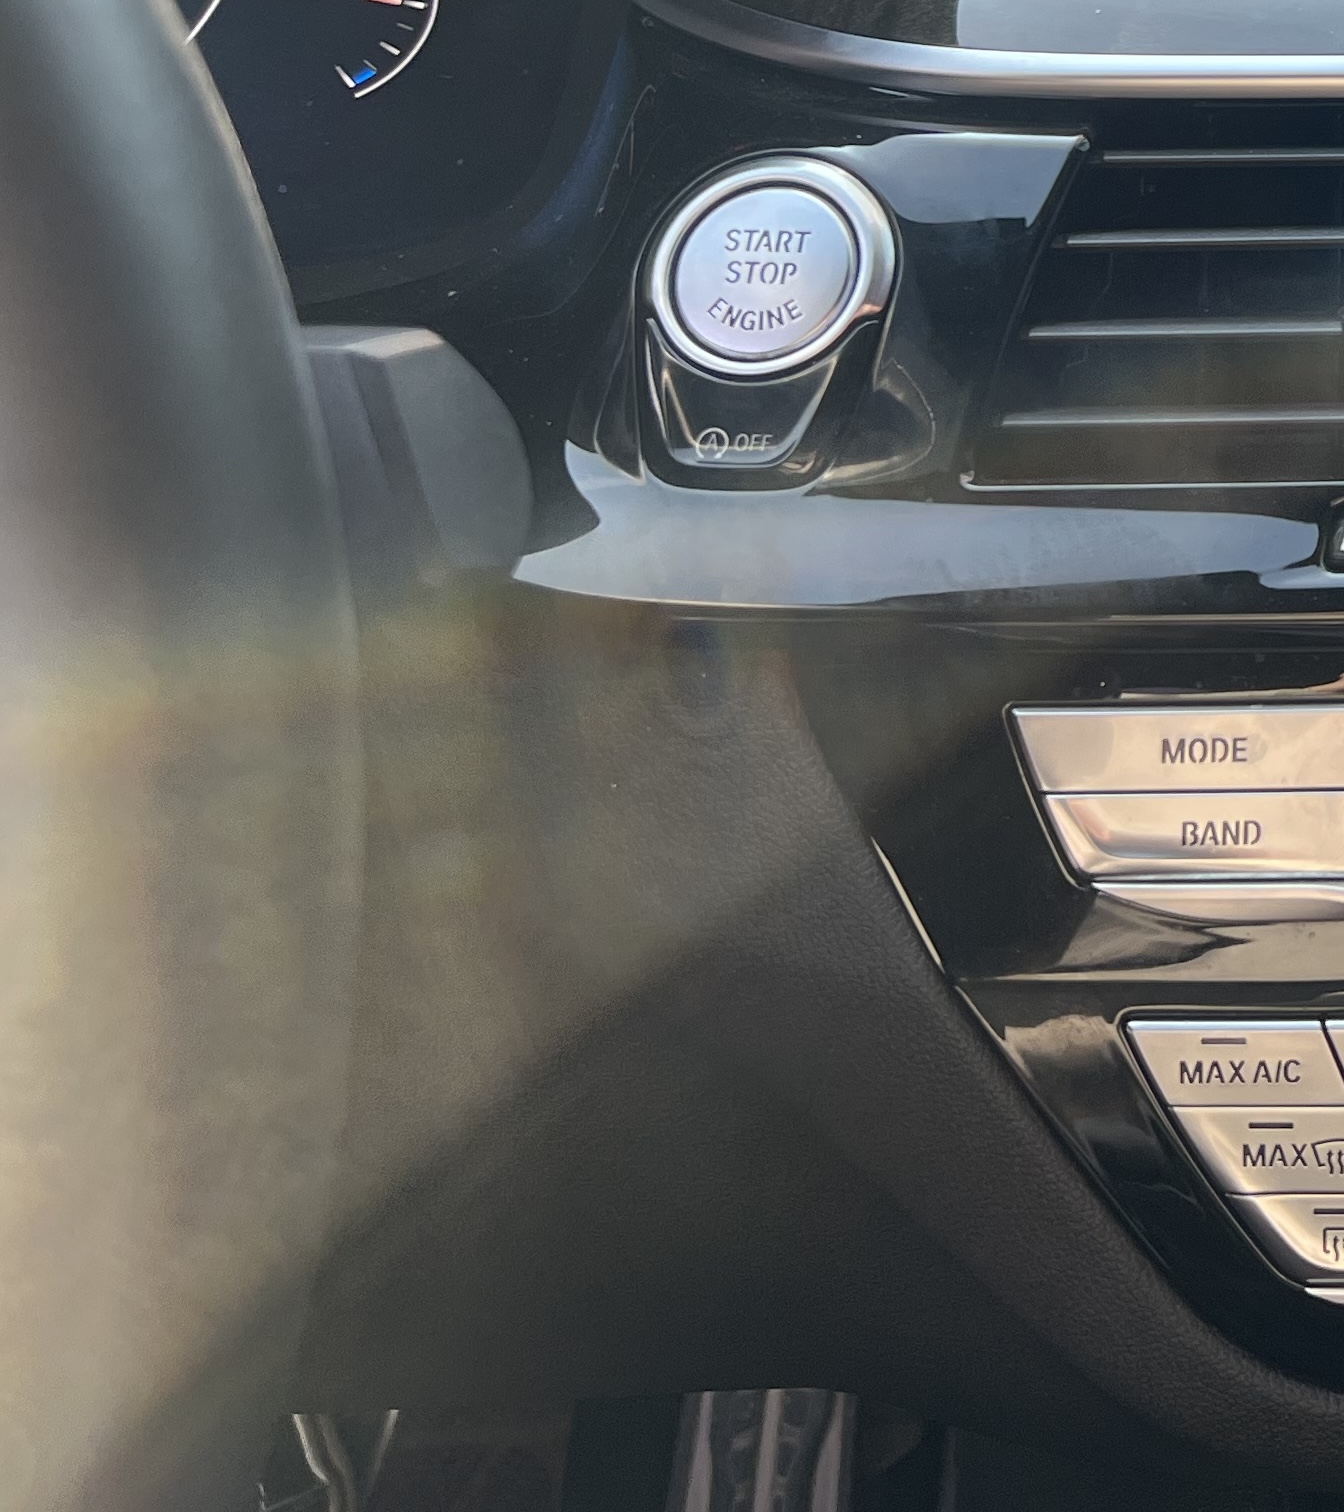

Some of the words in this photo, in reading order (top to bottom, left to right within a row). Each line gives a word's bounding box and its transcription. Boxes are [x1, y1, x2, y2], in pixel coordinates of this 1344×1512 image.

[725, 229, 812, 253] START
[726, 261, 798, 285] STOP
[707, 297, 804, 331] ENGINE
[734, 433, 774, 452] OFF
[1160, 737, 1248, 764] MODE
[1181, 819, 1262, 847] BAND
[1179, 1059, 1246, 1085] MAX
[1252, 1058, 1302, 1085] A/C
[1242, 1143, 1308, 1169] MAX
